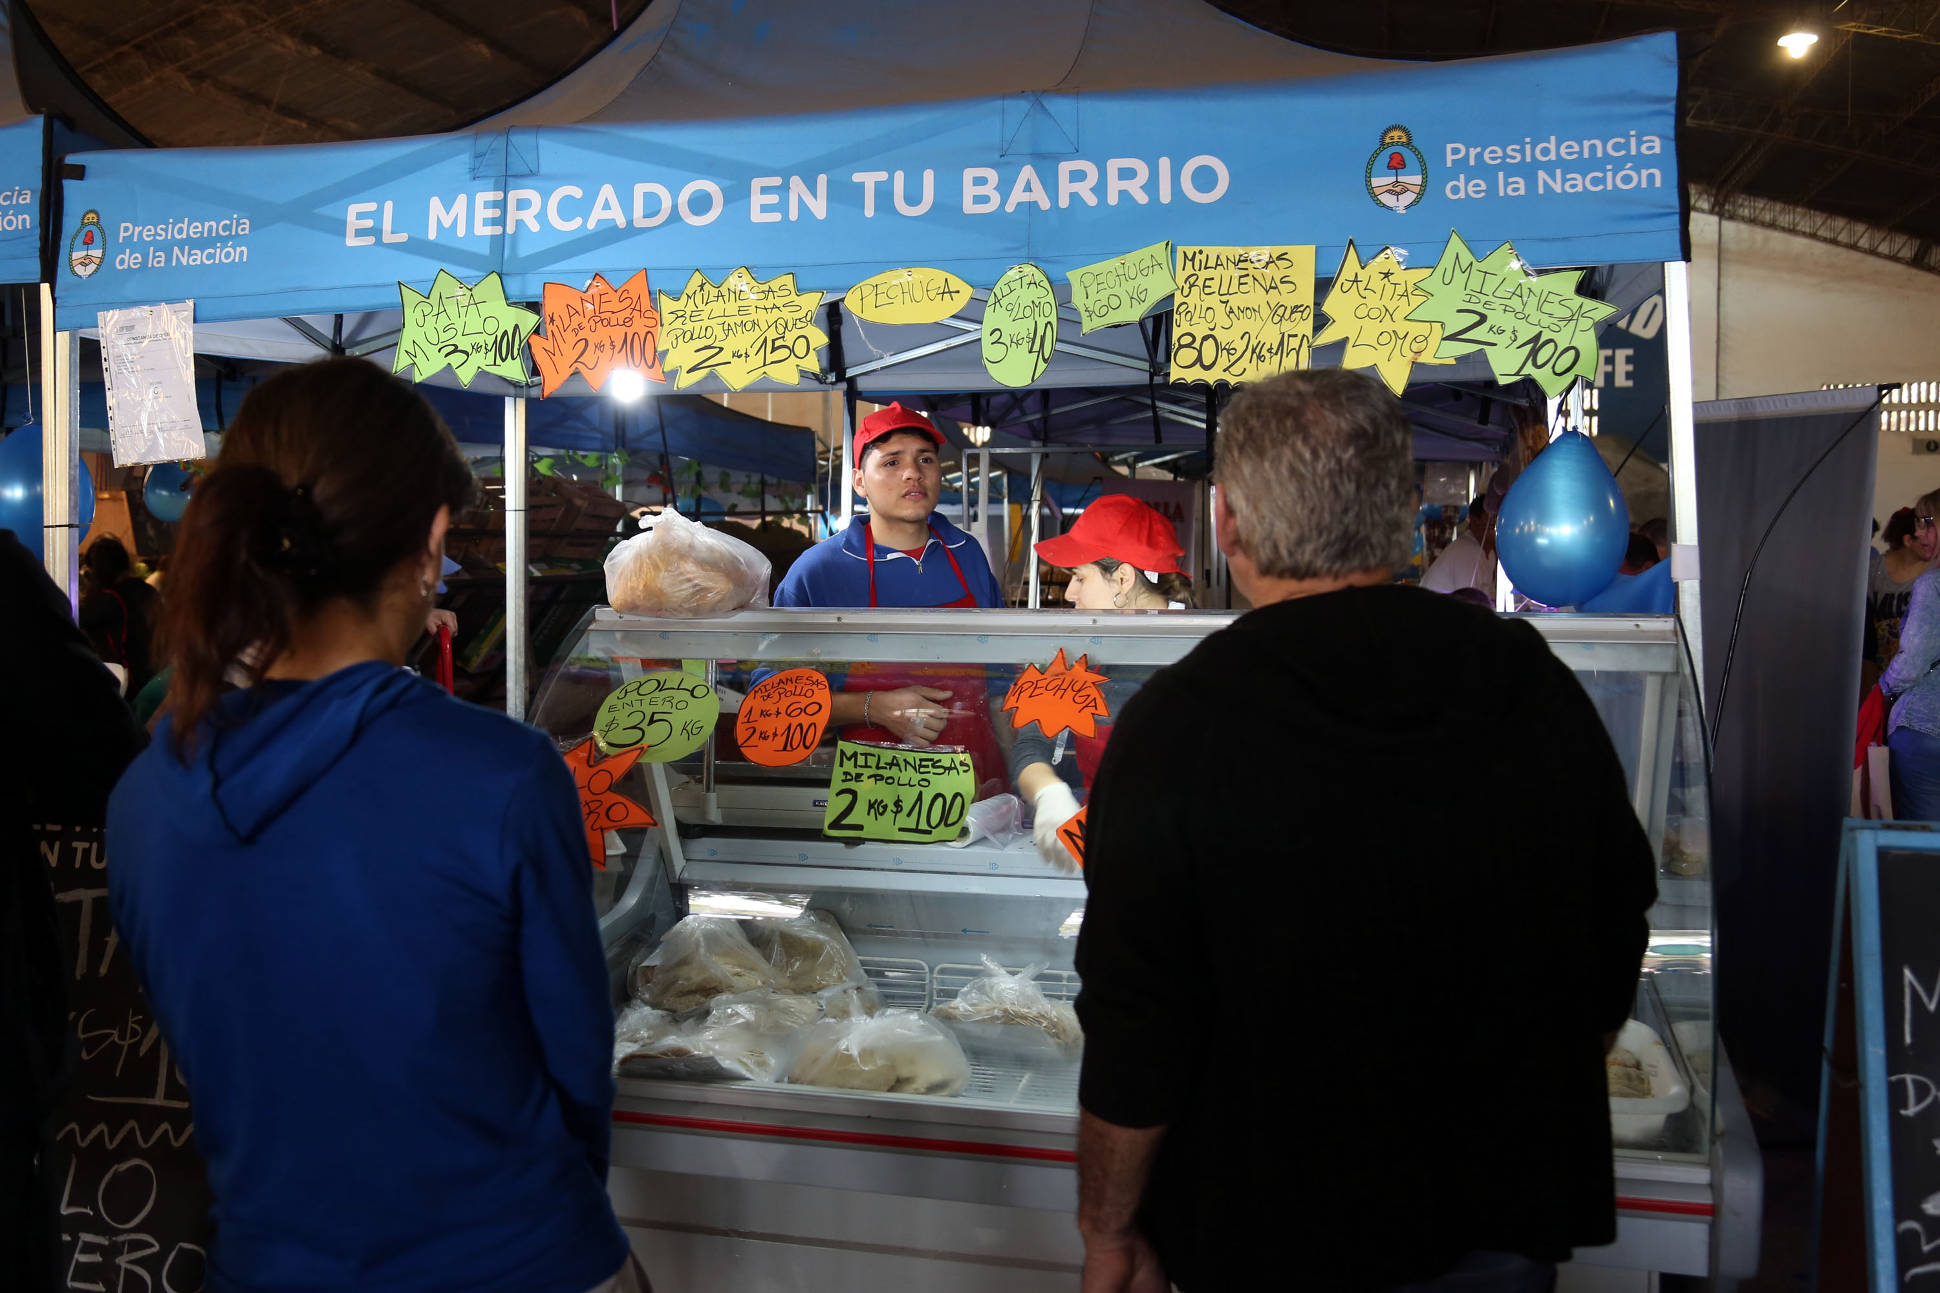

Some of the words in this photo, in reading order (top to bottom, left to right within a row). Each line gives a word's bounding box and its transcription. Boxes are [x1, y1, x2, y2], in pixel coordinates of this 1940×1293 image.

[1446, 130, 1662, 168] Presidencia
[1445, 175, 1488, 200] de
[1497, 170, 1527, 197] la
[1537, 162, 1662, 195] Nación
[345, 200, 409, 247] EL
[427, 179, 724, 241] MERCADO
[749, 173, 828, 223] EN
[851, 168, 935, 218] TU
[962, 154, 1231, 215] BARRIO
[118, 213, 251, 243] Presidencia
[115, 248, 142, 270] de
[147, 246, 166, 268] la
[171, 241, 249, 267] Nación
[1080, 252, 1164, 300] PECHUGA
[1181, 273, 1298, 302] RELLENAS
[851, 276, 961, 314] PECHUGA
[987, 272, 1050, 314] ALITAS
[1084, 293, 1122, 322] $60
[1125, 282, 1149, 309] KG
[1441, 252, 1600, 345] MILANESAS
[412, 291, 487, 328] PATA
[667, 300, 803, 326] RELLENAS
[1219, 299, 1264, 330] JAMON
[1354, 302, 1400, 324] CON
[1462, 292, 1497, 312] DE
[1500, 302, 1562, 334] POLLO
[571, 322, 586, 338] DE
[587, 315, 634, 333] POLLO
[717, 318, 763, 342] JAMON
[1351, 323, 1433, 362] LOMO
[1441, 308, 1499, 347] 2
[1487, 324, 1505, 336] KG
[438, 343, 470, 370] 3
[569, 337, 600, 371] 2
[686, 344, 732, 374] 2
[985, 328, 1009, 364] 3
[1009, 333, 1025, 350] KG
[1222, 331, 1251, 377] 2
[616, 677, 710, 700] POLLO
[753, 675, 828, 700] MILANESAS
[760, 692, 774, 702] DE
[773, 686, 815, 705] POLLO
[1012, 678, 1099, 714] PECHUGA
[608, 695, 689, 714] ENTERO
[741, 706, 759, 724] 1
[598, 710, 673, 748] $35
[680, 719, 705, 741] KG
[738, 726, 759, 748] 2
[839, 748, 971, 777] MILANESAS
[841, 771, 866, 783] DE
[867, 773, 932, 788] POLLO
[827, 788, 864, 832] 2
[866, 797, 889, 822] KG
